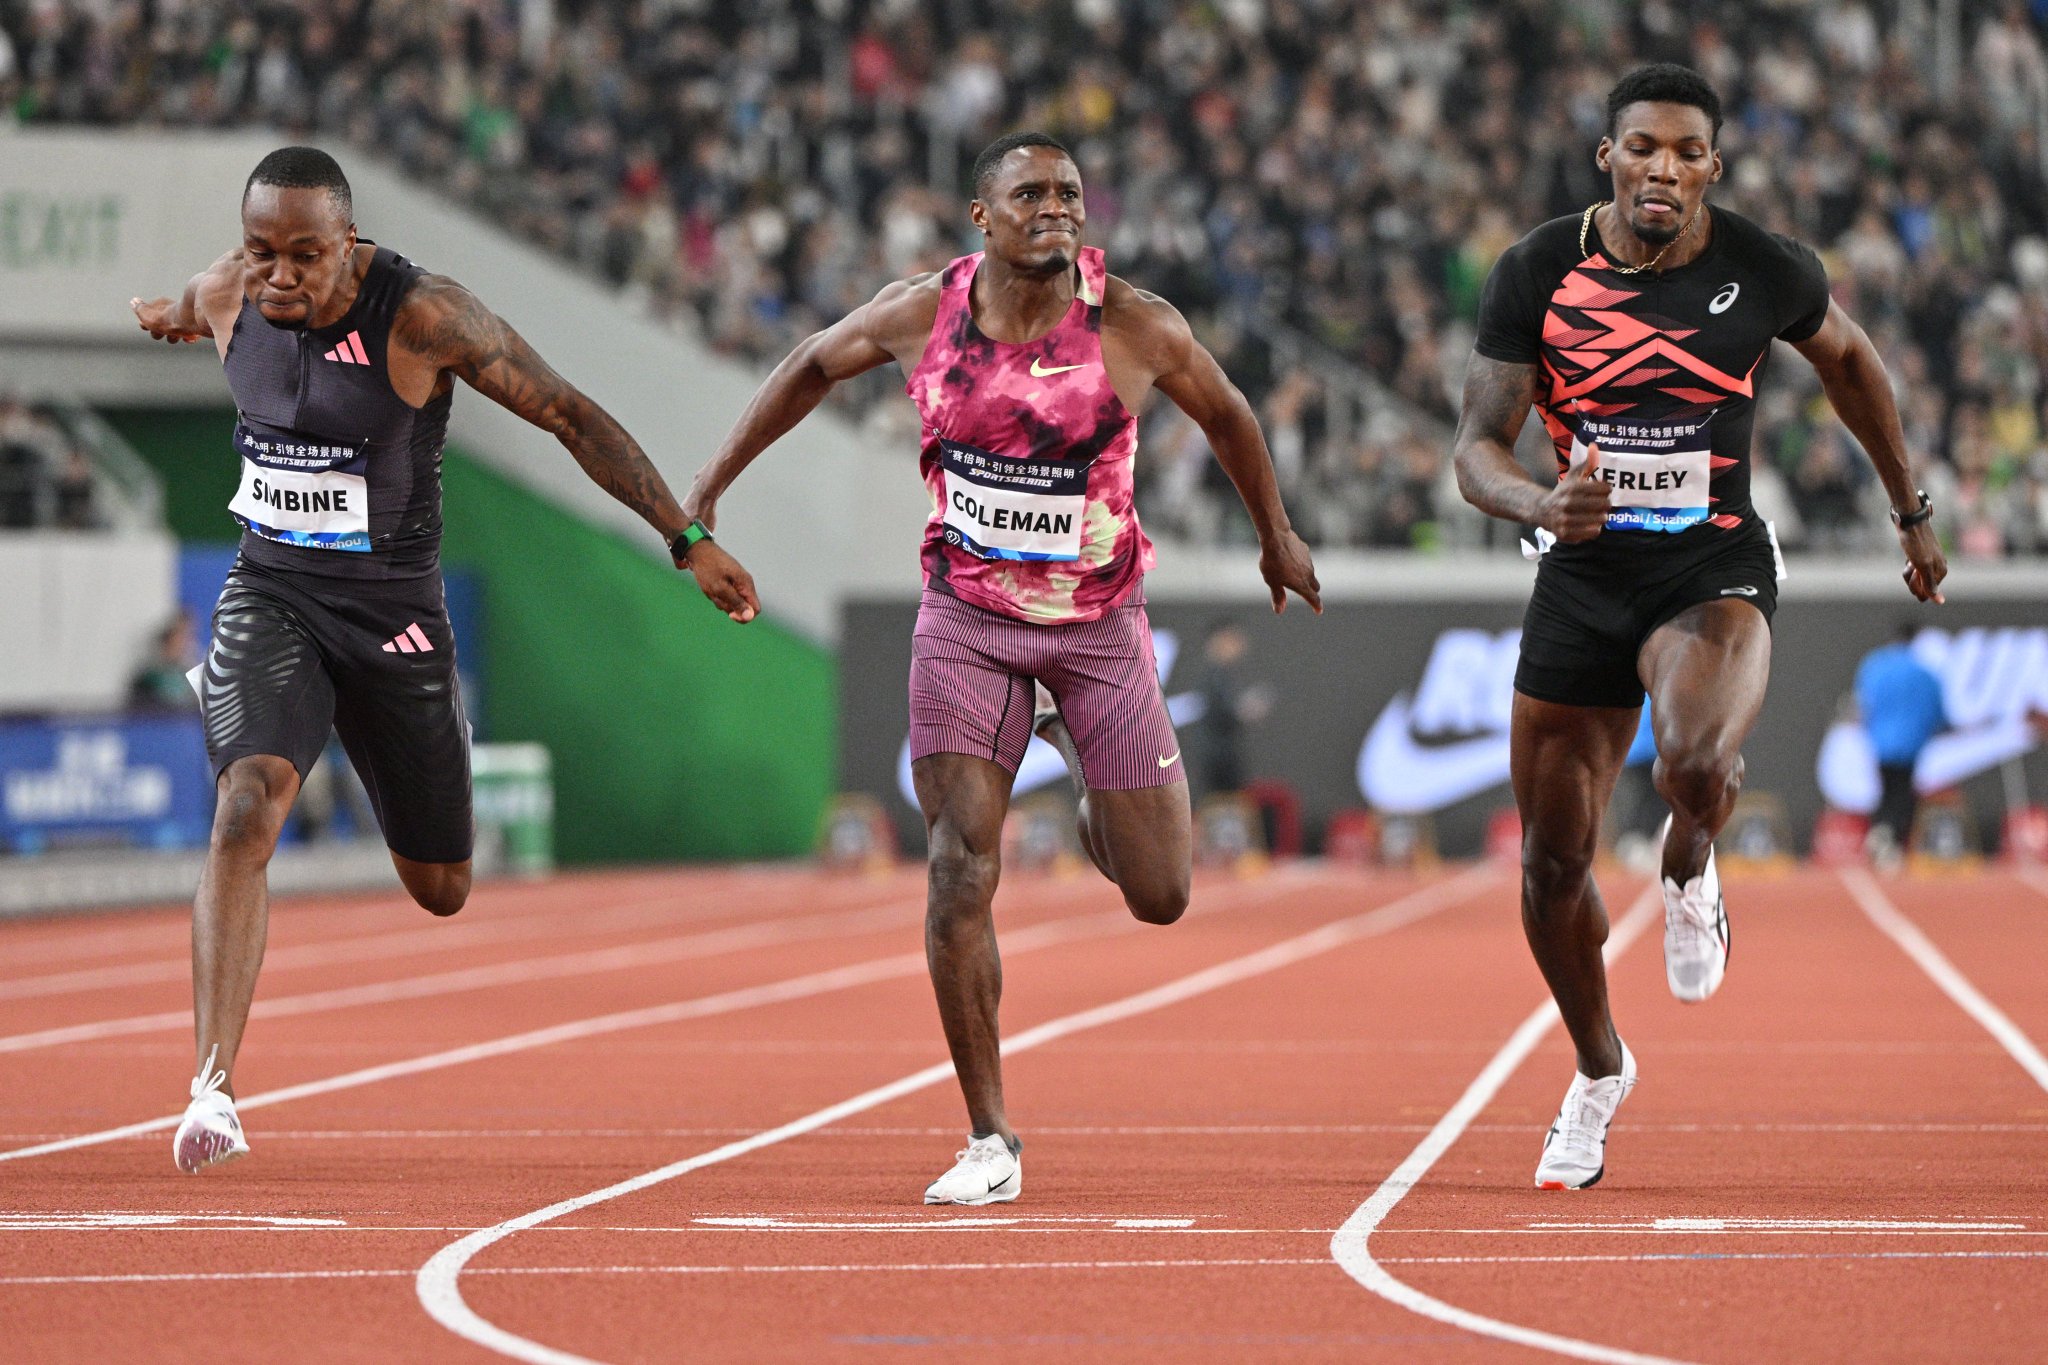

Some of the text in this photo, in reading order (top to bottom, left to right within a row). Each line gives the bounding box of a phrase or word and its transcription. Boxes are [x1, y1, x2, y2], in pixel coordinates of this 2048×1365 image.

[1583, 419, 1696, 438] 倍明·引领全场景照明
[1595, 436, 1676, 448] SPORTSBEAMS
[256, 453, 332, 467] SPORTSBEAMS
[968, 468, 1053, 487] SPORTSBEAMS
[252, 478, 348, 512] SIMBINE
[953, 491, 1072, 534] COLEMAN
[1608, 512, 1643, 523] nghai
